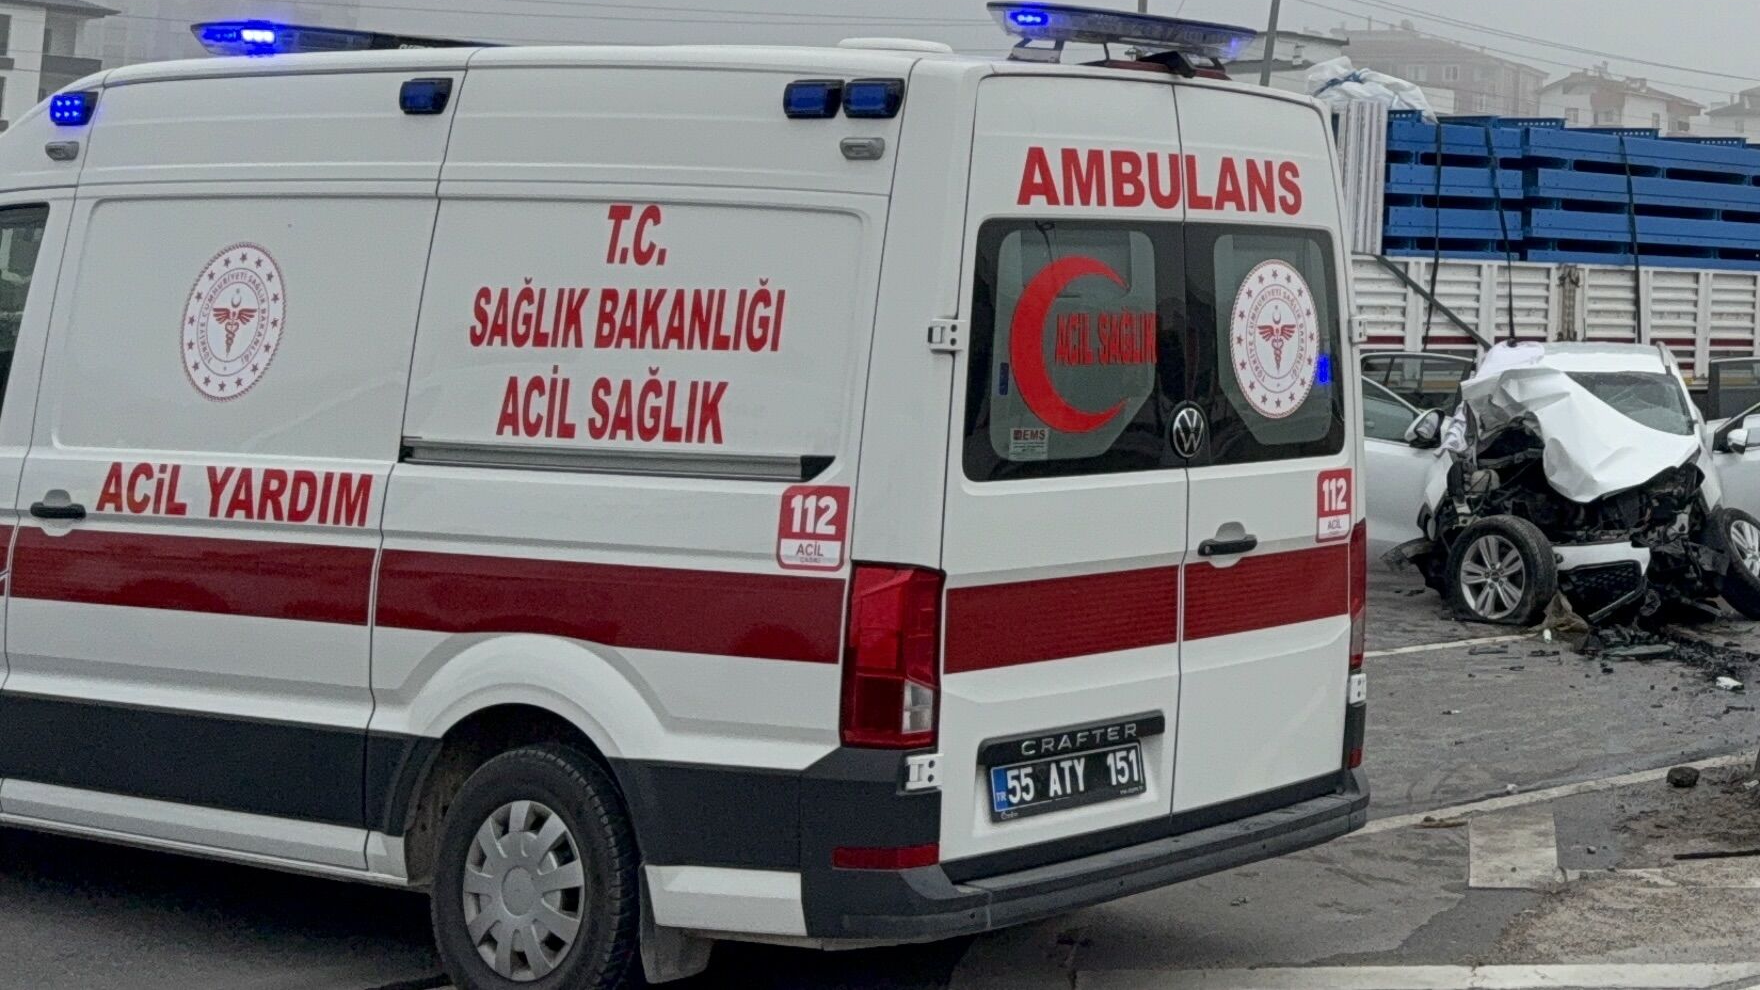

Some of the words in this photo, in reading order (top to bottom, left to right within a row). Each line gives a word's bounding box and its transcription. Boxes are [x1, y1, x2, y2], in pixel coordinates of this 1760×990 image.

[1016, 146, 1302, 216] AMBULANS
[606, 205, 667, 266] T.C.
[469, 277, 590, 349] SAĞLIK
[593, 278, 786, 352] BAKANLIĞI
[496, 365, 576, 440] ACİL
[587, 366, 728, 444] SAĞLIK
[206, 465, 374, 527] YARDIM
[790, 494, 838, 536] 112
[1322, 477, 1347, 512] 112
[1021, 723, 1137, 756] CRAFTER
[1006, 766, 1035, 805] 55
[1049, 757, 1086, 798] ATY
[1106, 748, 1141, 786] 151
